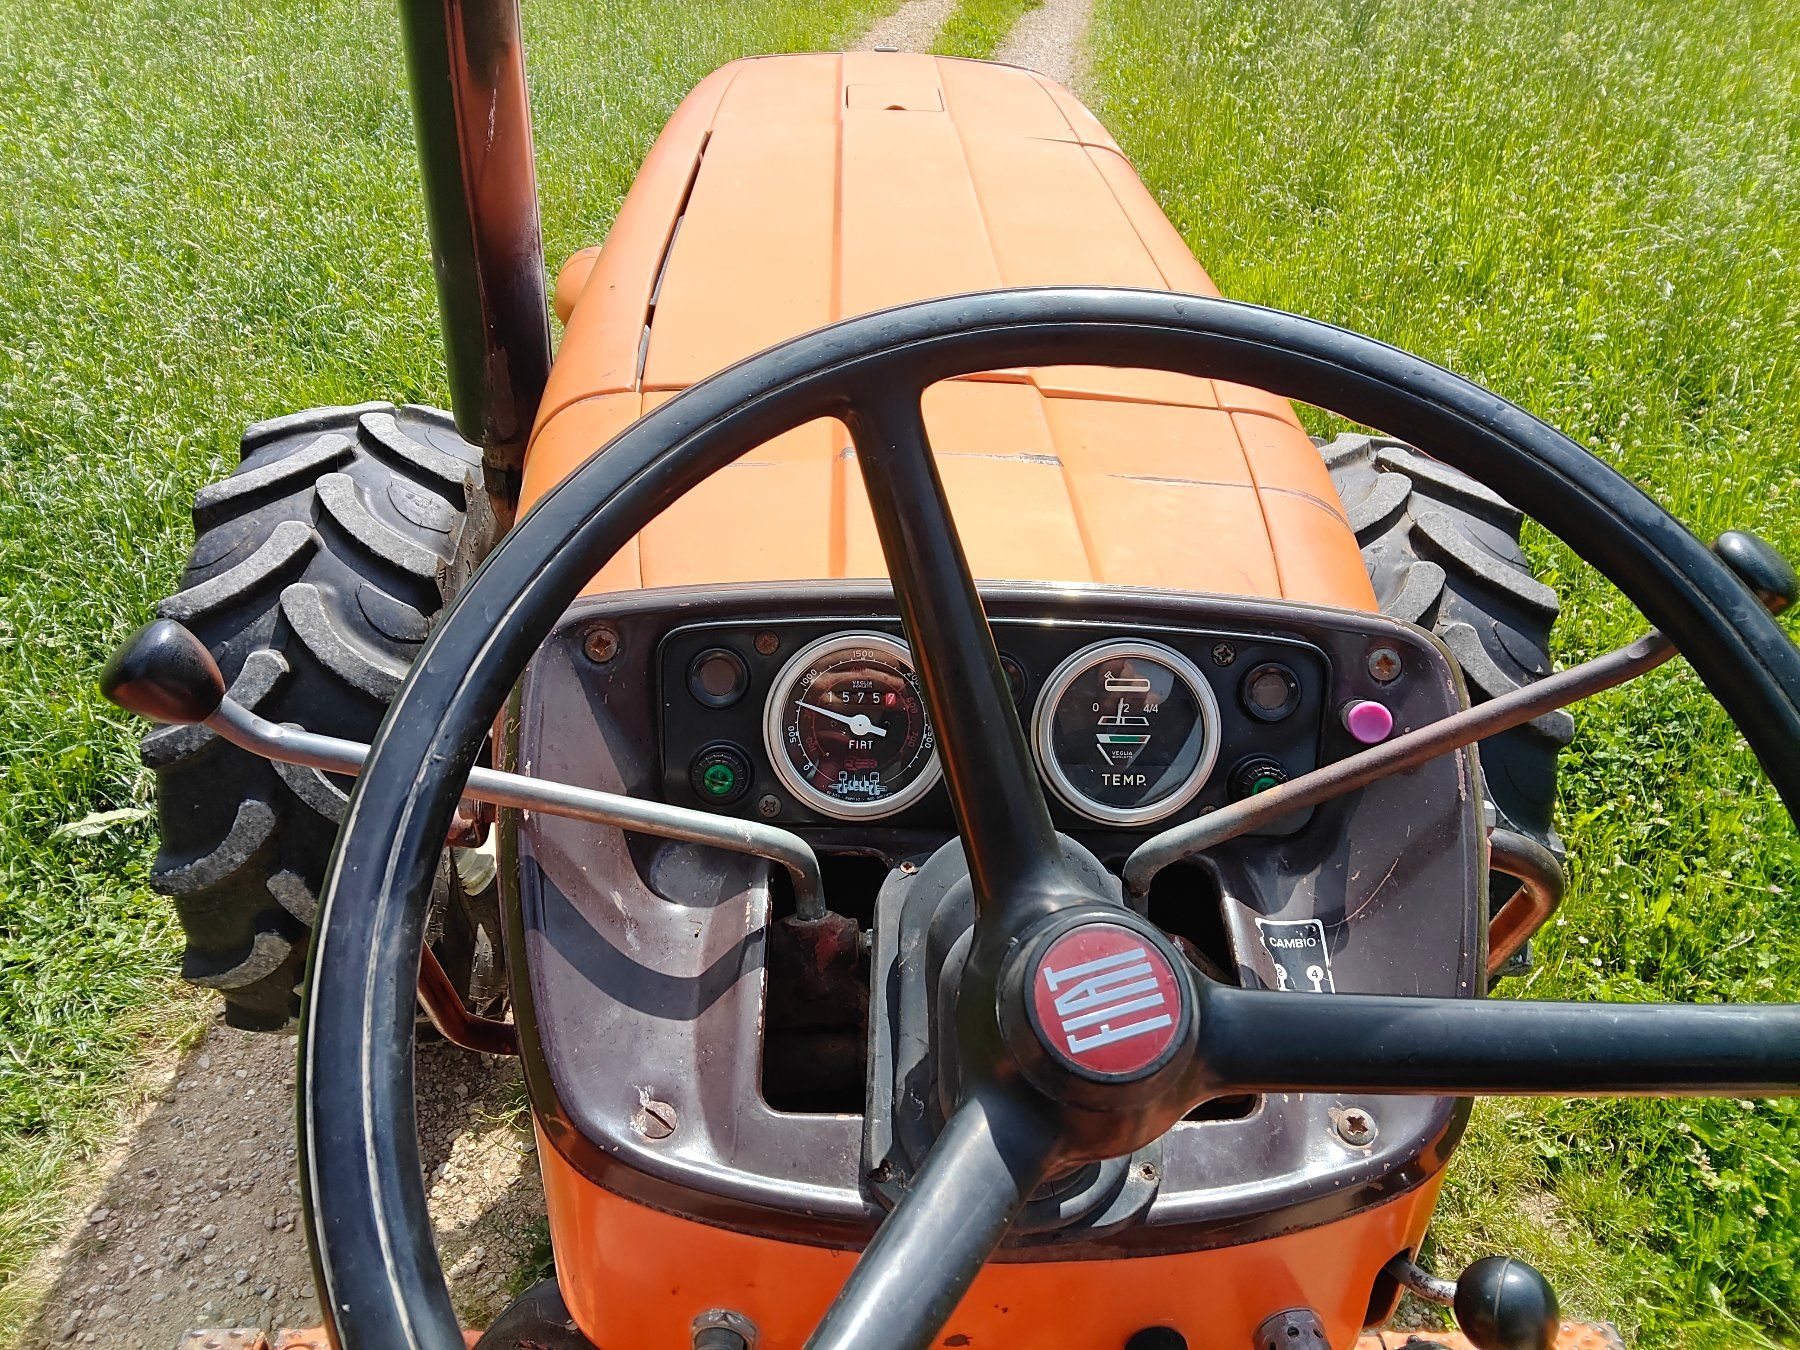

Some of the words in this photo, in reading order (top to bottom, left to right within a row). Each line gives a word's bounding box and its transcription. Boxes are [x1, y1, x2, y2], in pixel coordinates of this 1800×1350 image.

[852, 650, 874, 658] 1500
[800, 668, 818, 687] 1000
[1092, 702, 1100, 712] 0
[1143, 703, 1159, 713] 4/4
[788, 725, 797, 744] 500
[848, 740, 874, 750] FIAT
[1101, 773, 1147, 786] TEMP.
[1268, 936, 1317, 949] CAMBIO
[1277, 967, 1284, 977] 2
[1311, 969, 1319, 979] 4
[1043, 947, 1173, 1055] FIAT
